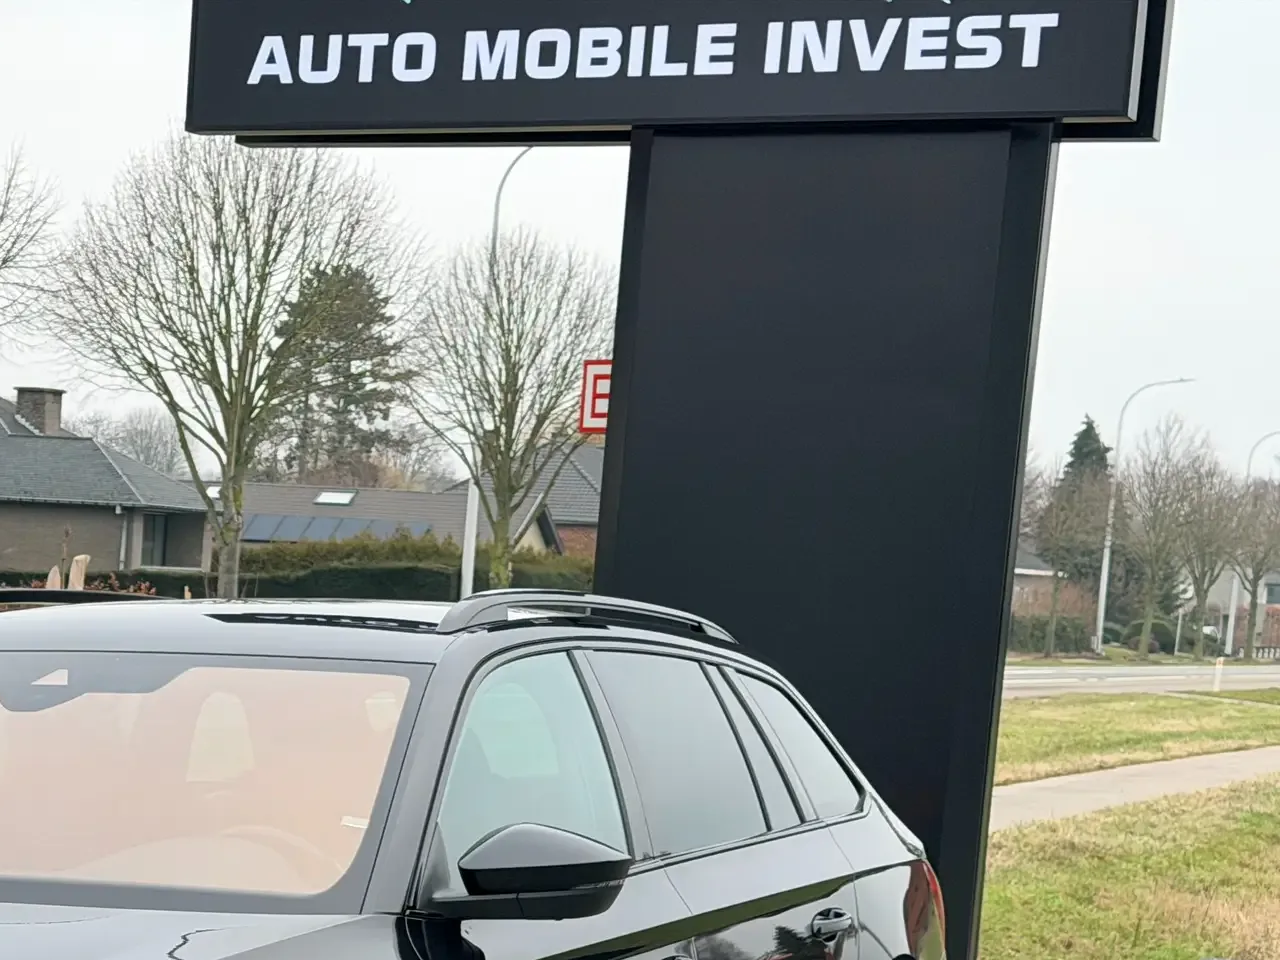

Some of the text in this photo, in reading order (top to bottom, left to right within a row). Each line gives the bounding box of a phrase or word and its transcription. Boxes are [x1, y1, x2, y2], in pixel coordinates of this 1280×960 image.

[246, 12, 1060, 85] AUTO MOBILE INVEST
